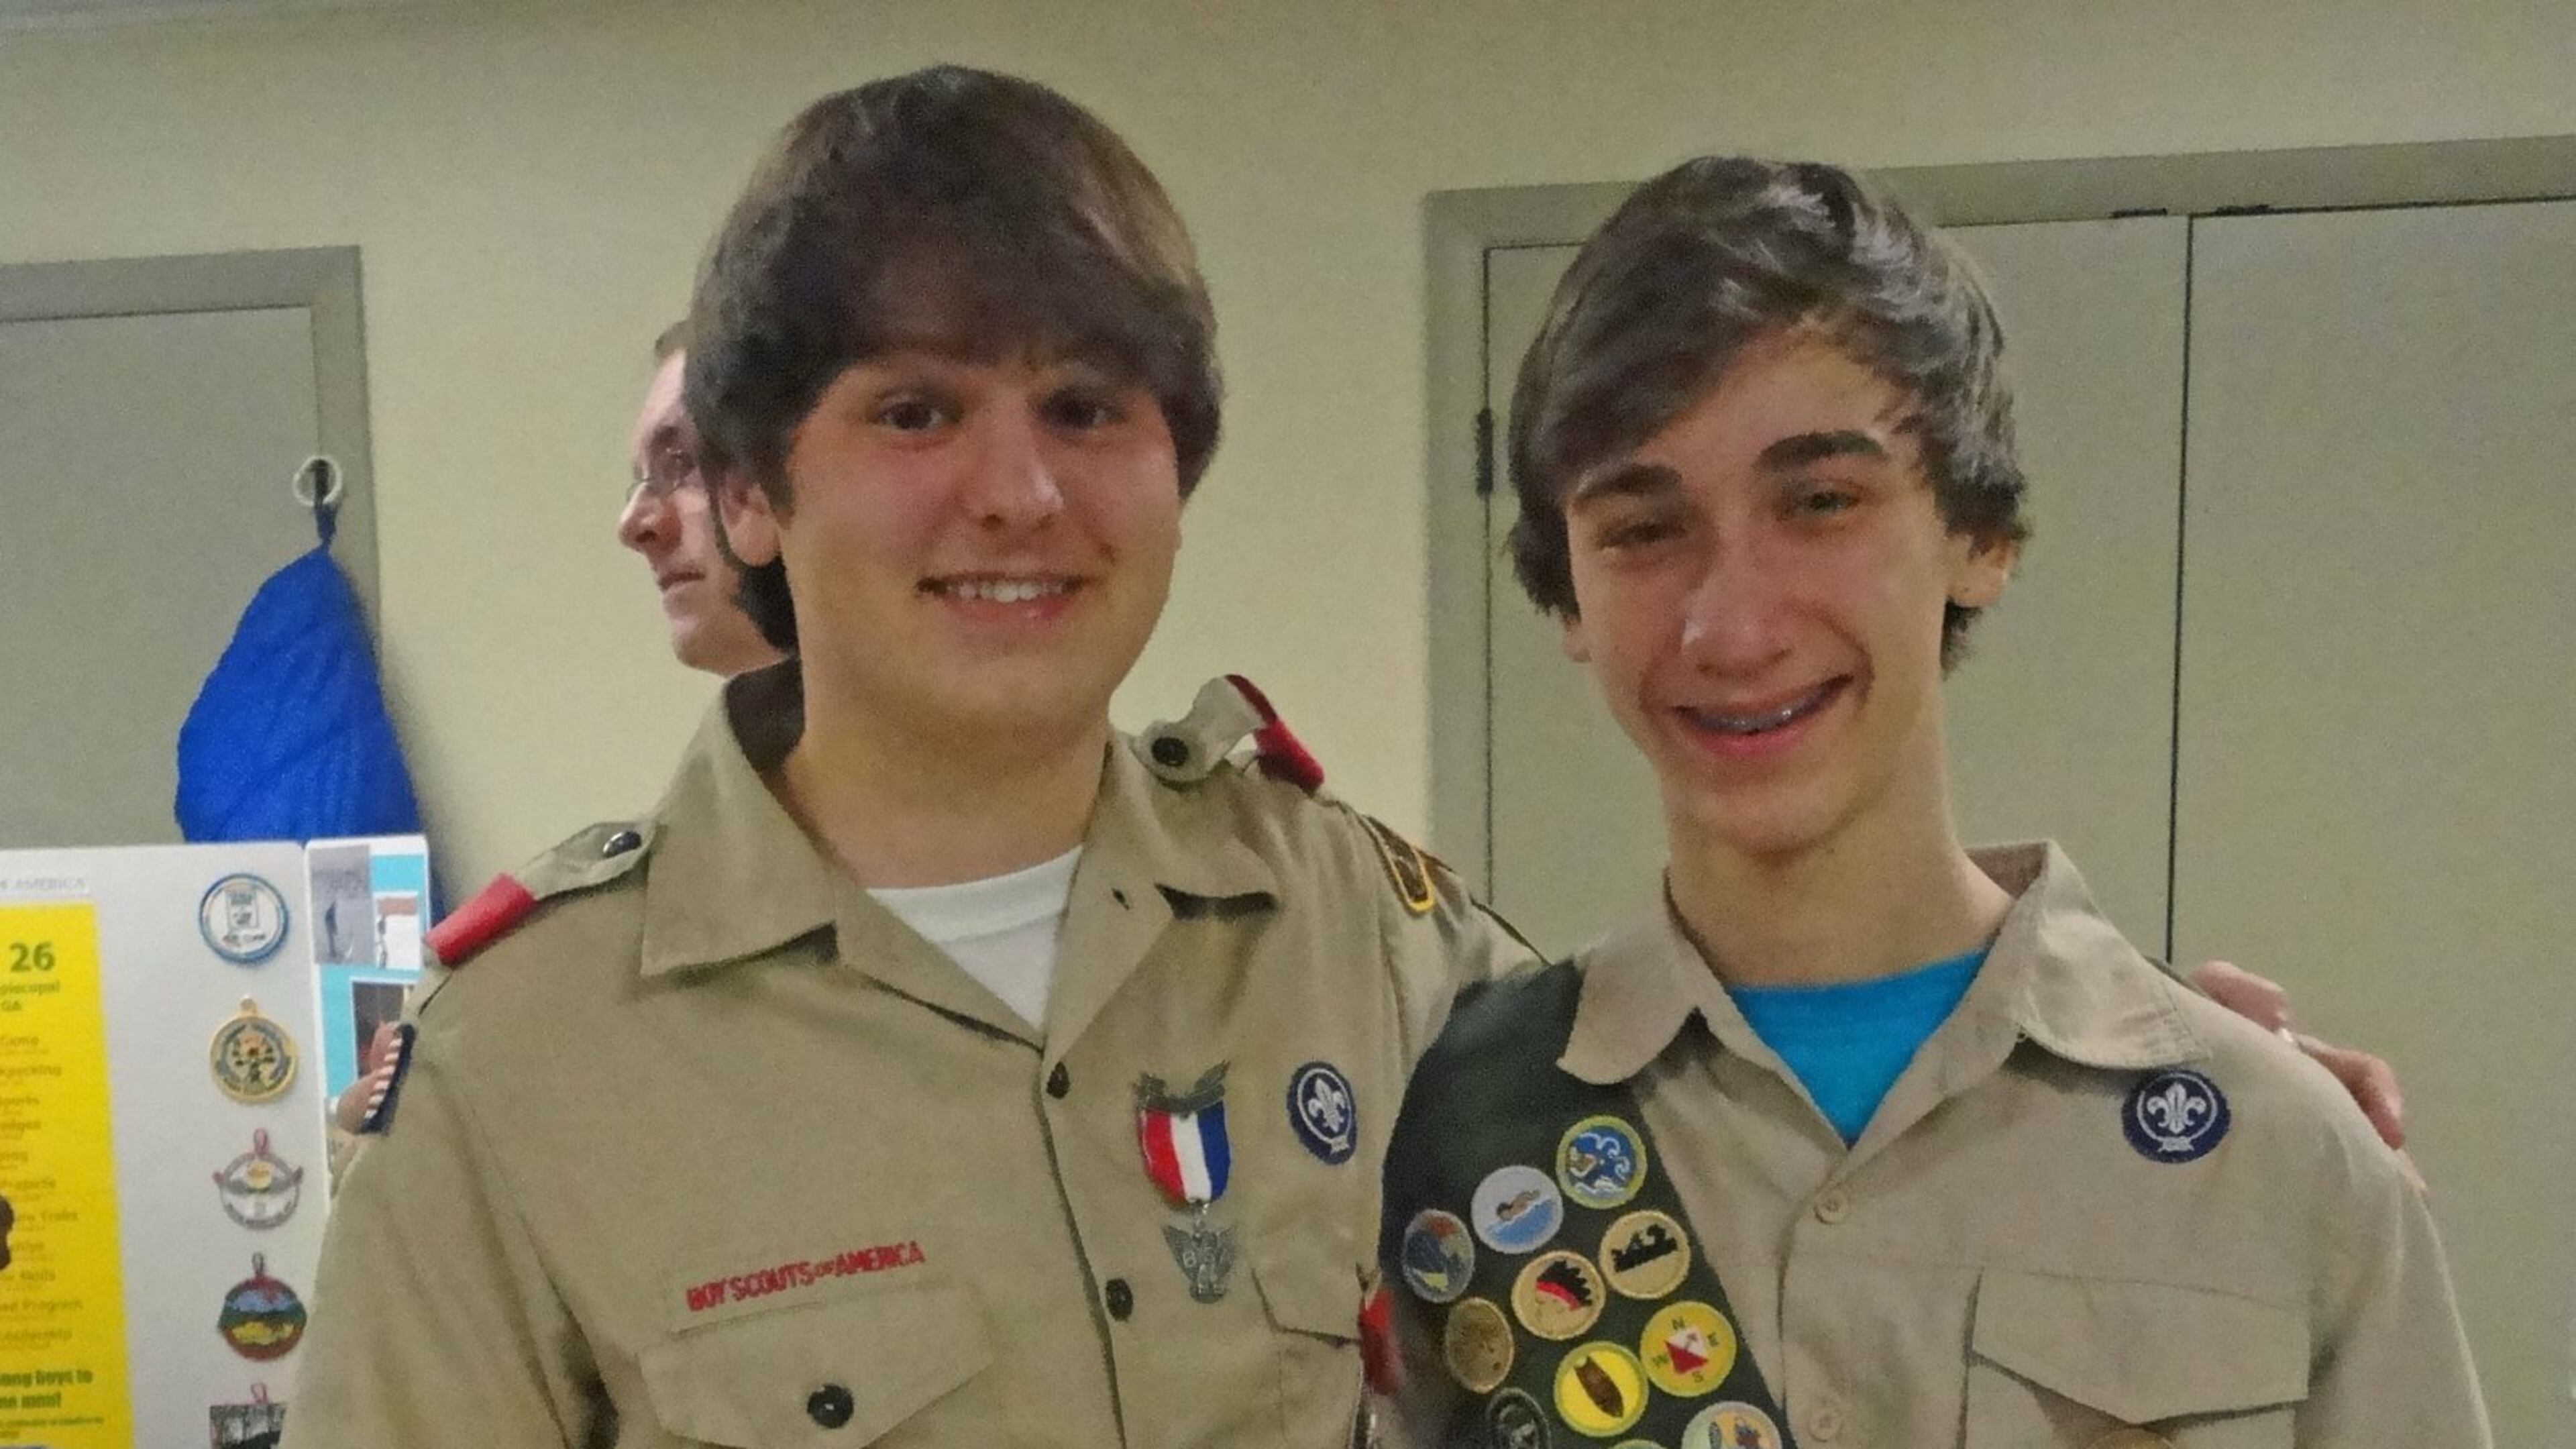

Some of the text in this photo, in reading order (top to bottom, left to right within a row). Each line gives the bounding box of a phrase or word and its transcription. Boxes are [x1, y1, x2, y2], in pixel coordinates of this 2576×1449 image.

[9, 941, 56, 973] 26
[686, 1279, 727, 1311] BOY
[729, 1262, 815, 1301] SCOUTS
[835, 1240, 926, 1277] AMERICA
[76, 1369, 93, 1384] to
